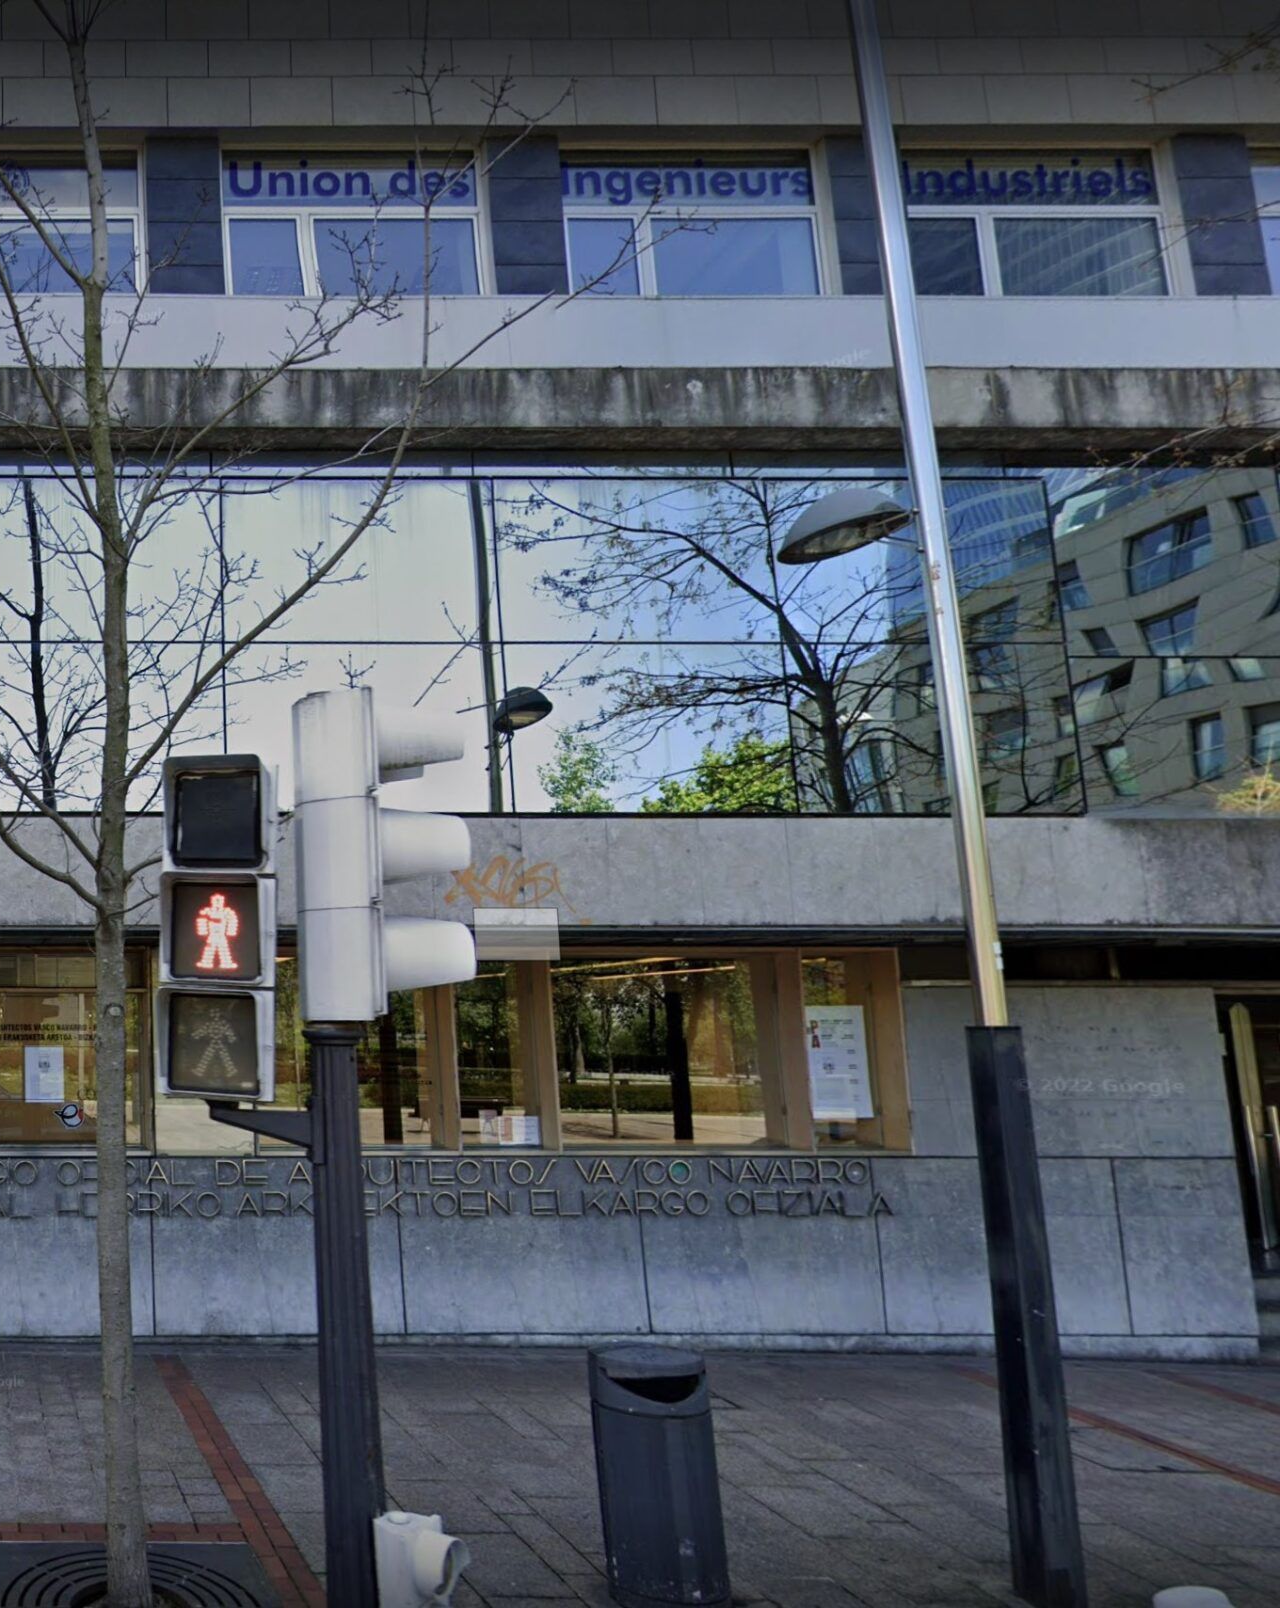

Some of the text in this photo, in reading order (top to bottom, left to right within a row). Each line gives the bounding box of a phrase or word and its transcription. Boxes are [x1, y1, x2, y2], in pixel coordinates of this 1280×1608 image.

[227, 159, 471, 198] Union des
[560, 158, 813, 206] Ingenieurs
[902, 157, 1154, 199] Industriels
[215, 1159, 269, 1186] DE
[710, 1158, 871, 1185] NAVARRO
[529, 1188, 710, 1217] ELKARGO
[726, 1189, 894, 1217] OFIZIALA
